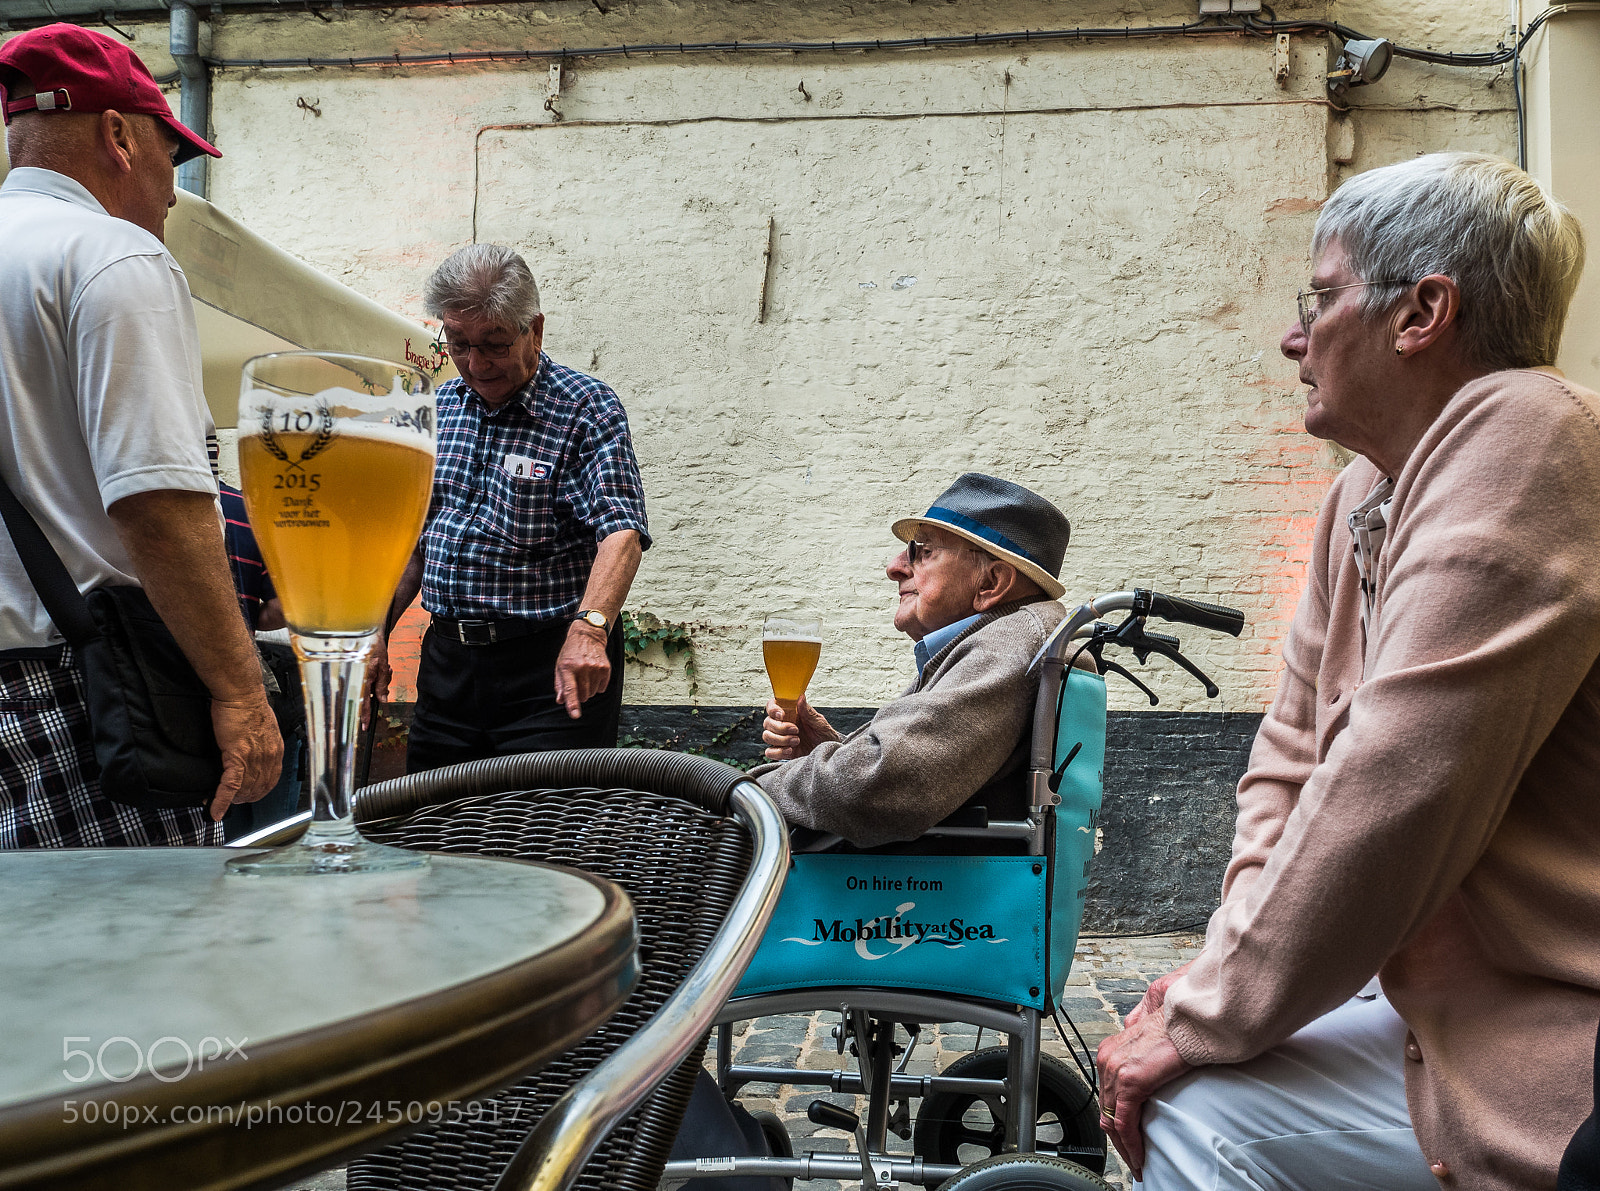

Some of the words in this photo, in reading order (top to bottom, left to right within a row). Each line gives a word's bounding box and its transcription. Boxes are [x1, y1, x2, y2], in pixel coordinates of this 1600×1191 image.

[280, 411, 314, 432] 10
[273, 473, 322, 492] 2015
[846, 876, 868, 891] On
[872, 875, 903, 891] hire
[907, 876, 943, 892] from
[812, 917, 931, 945] Mobility
[948, 918, 996, 941] Sea
